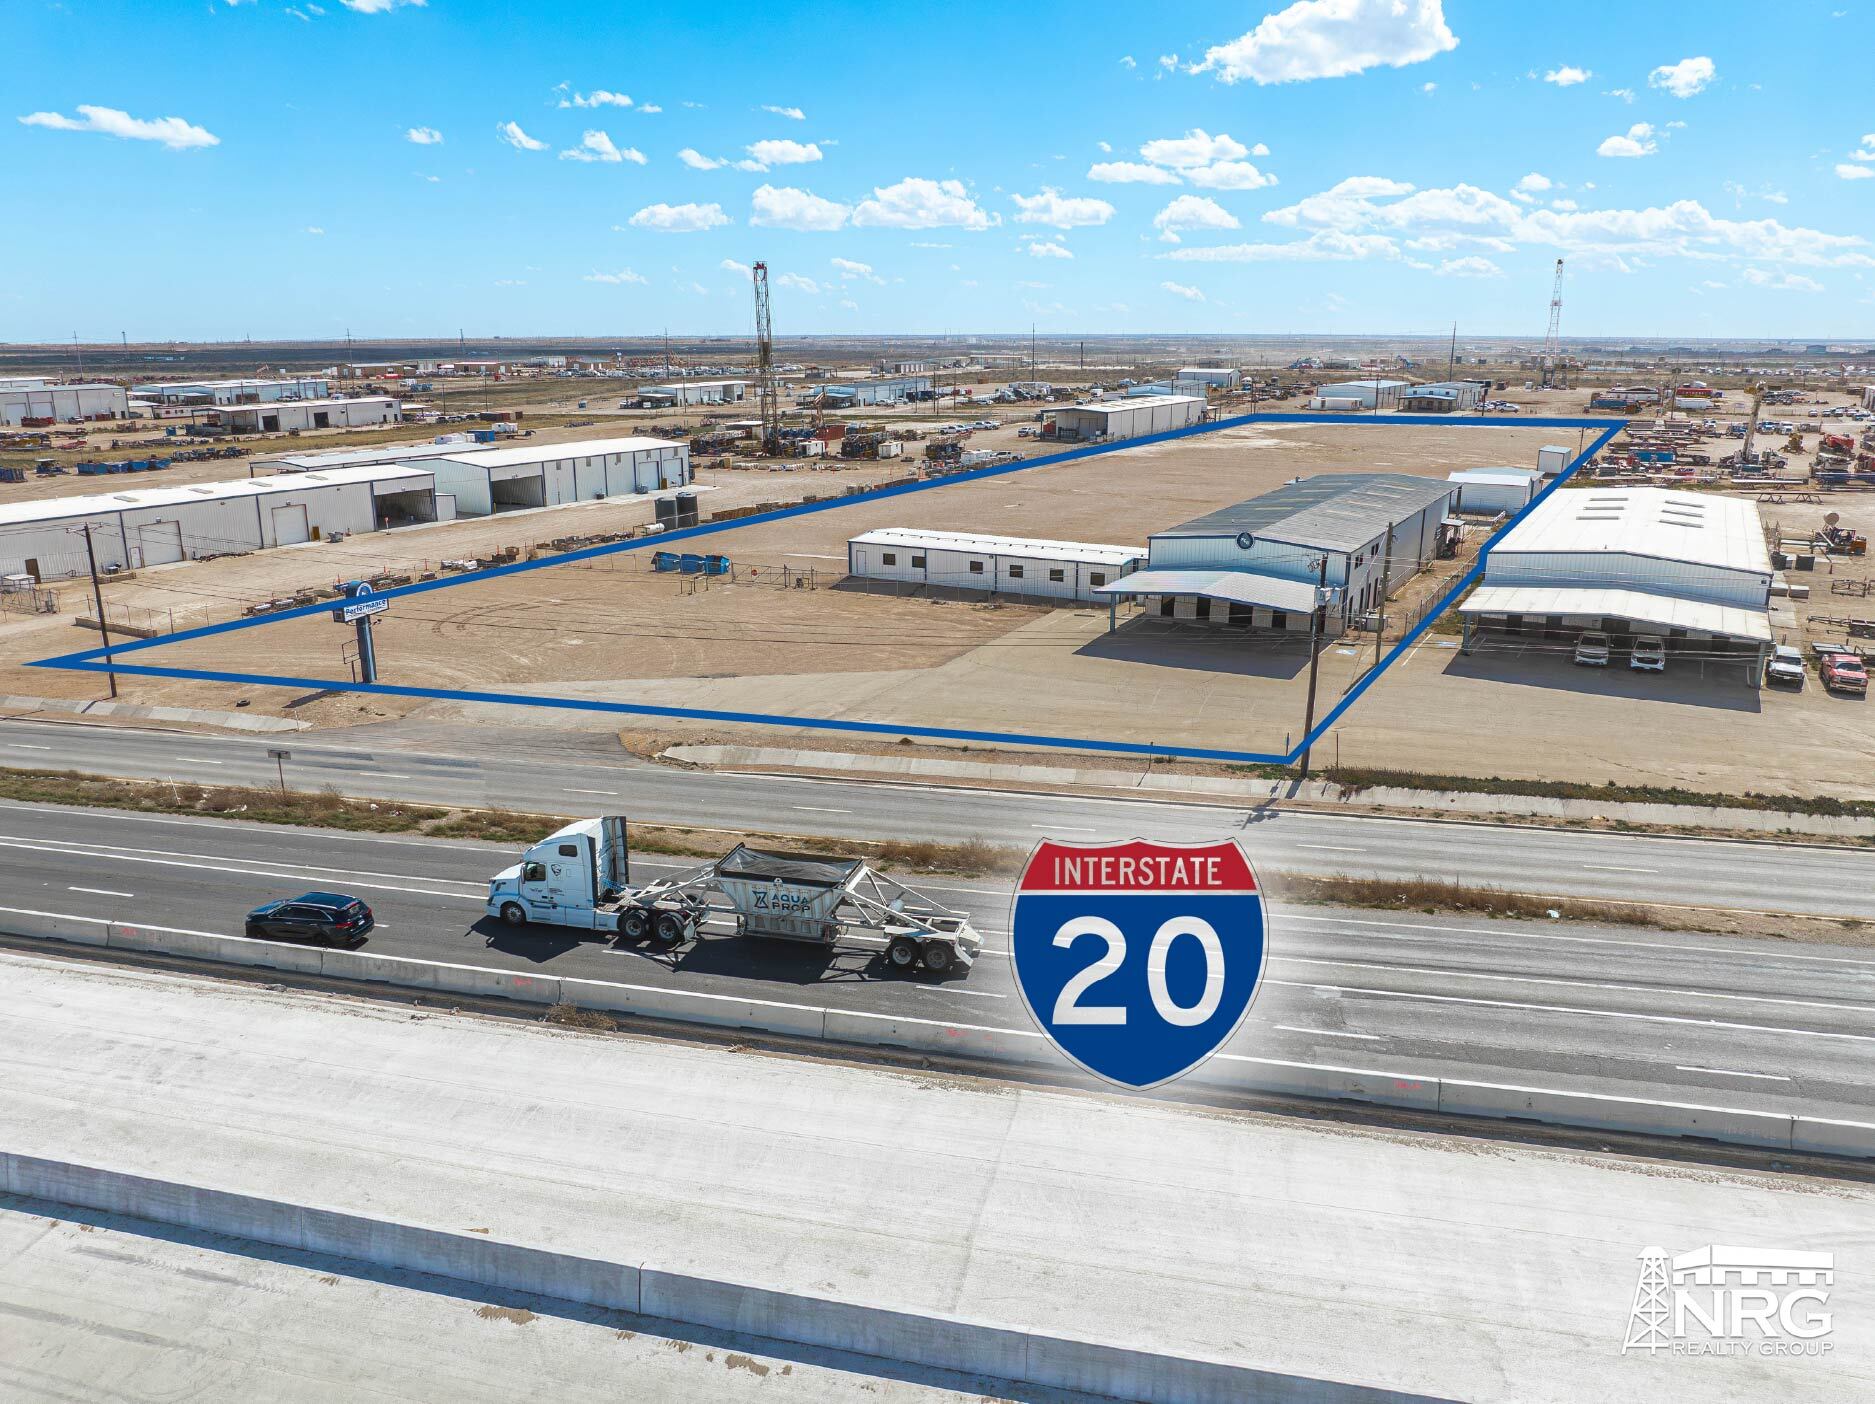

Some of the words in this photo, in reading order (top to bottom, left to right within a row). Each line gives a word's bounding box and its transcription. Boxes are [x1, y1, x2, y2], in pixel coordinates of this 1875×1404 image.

[345, 600, 386, 614] Performance
[772, 893, 809, 904] AQUA
[772, 902, 811, 913] PROP
